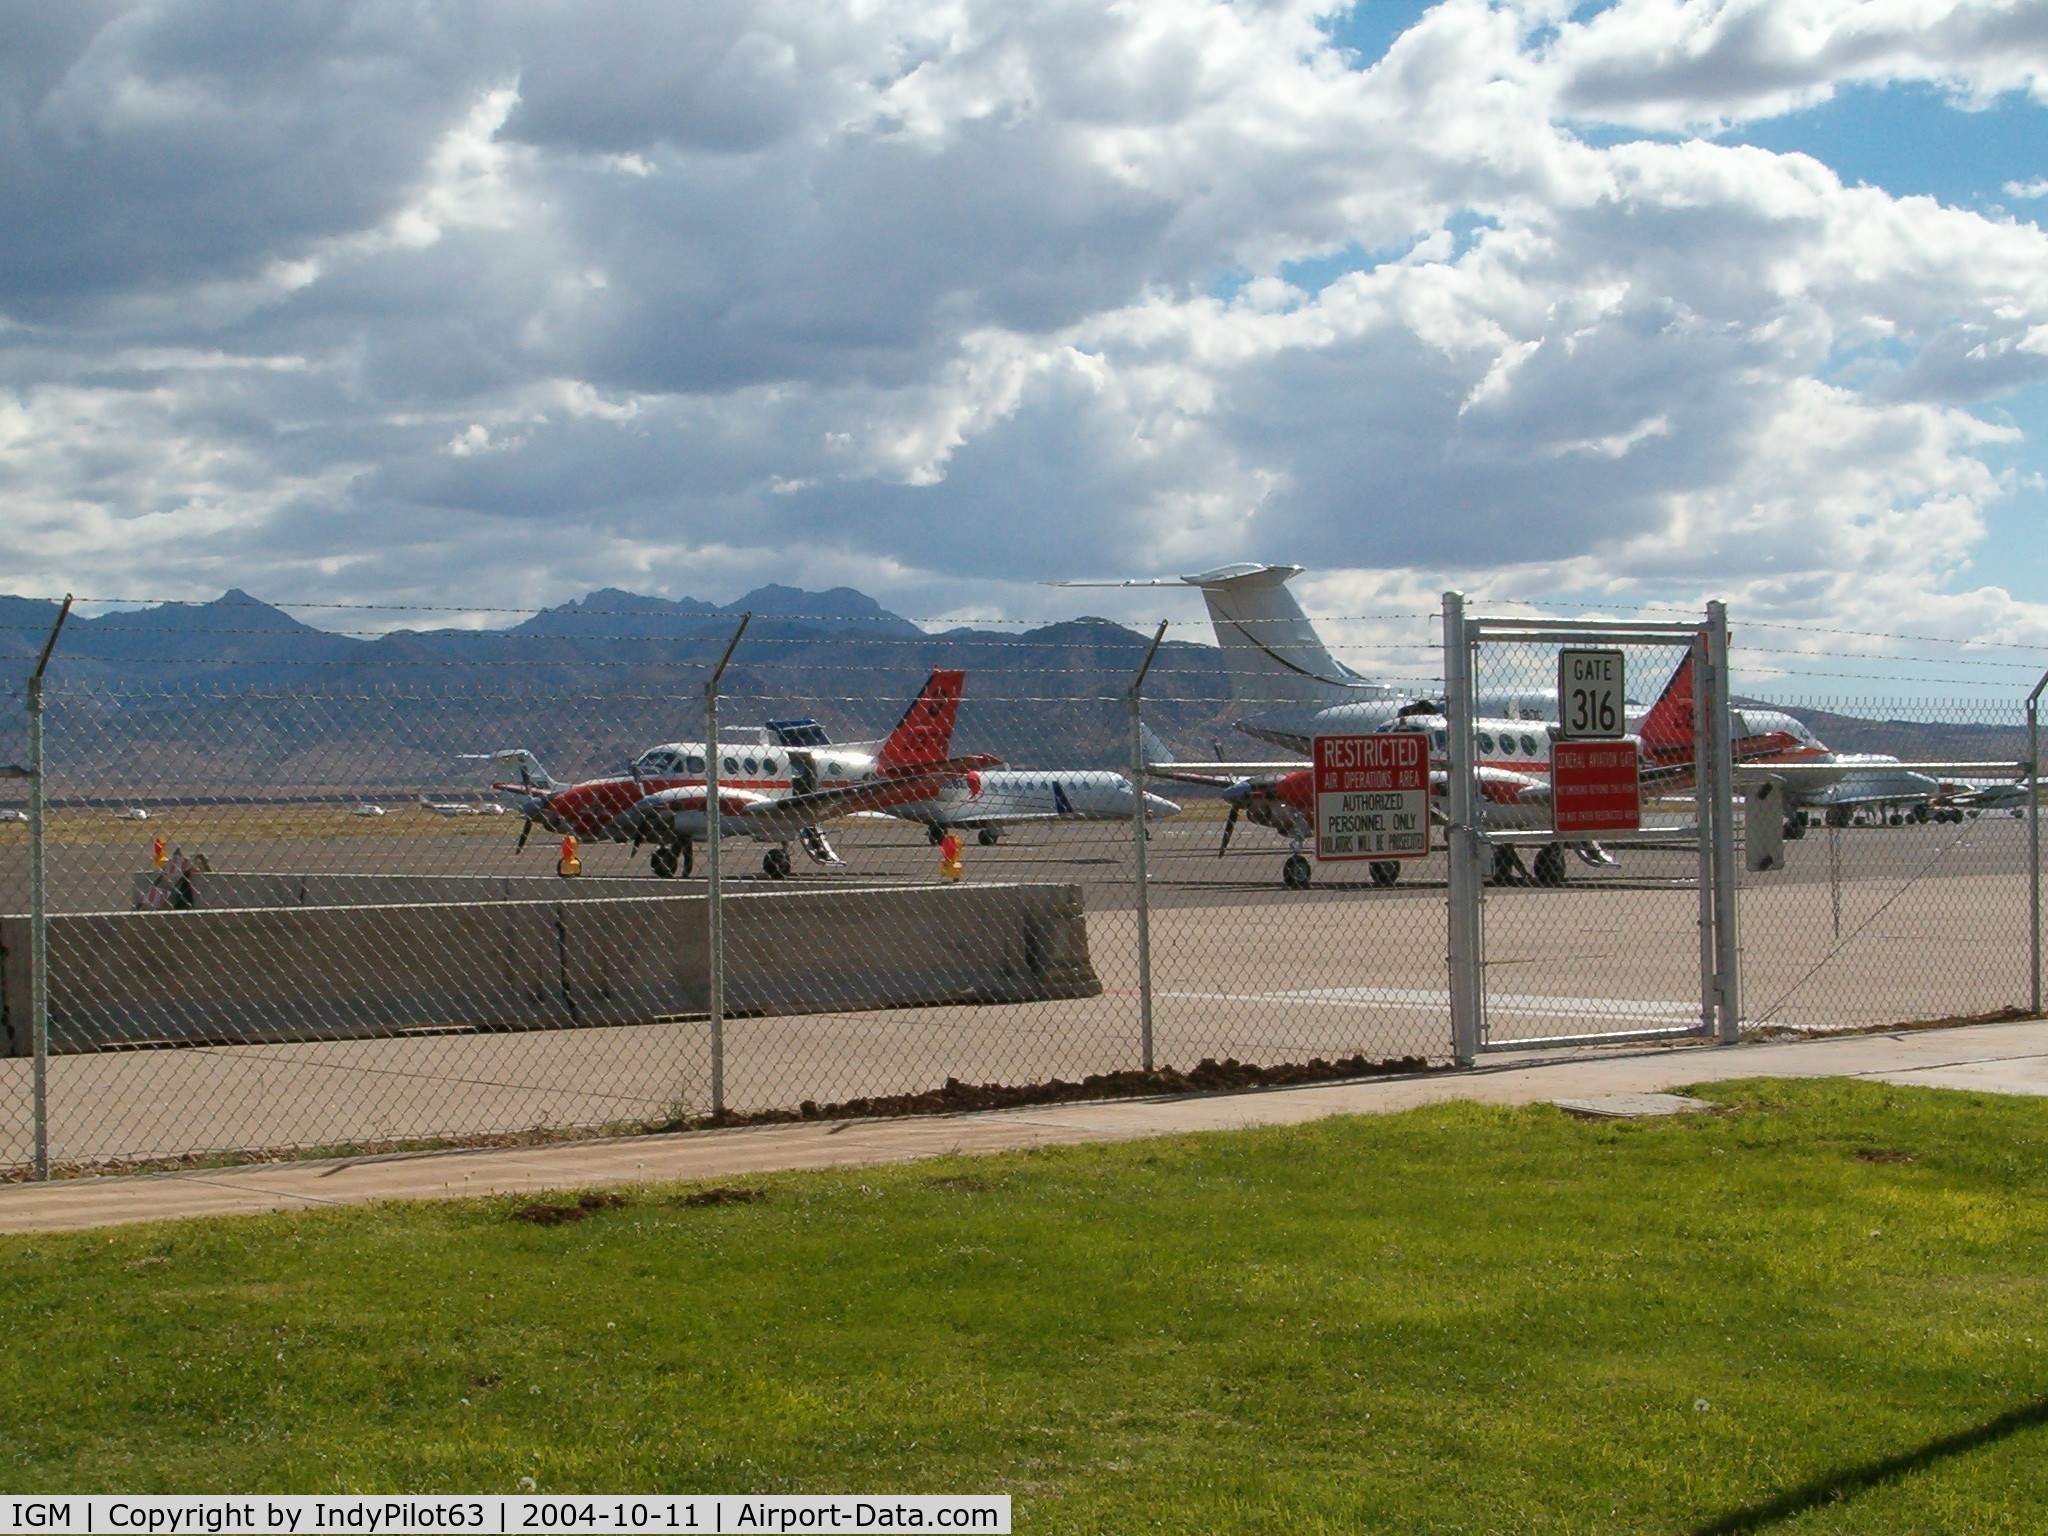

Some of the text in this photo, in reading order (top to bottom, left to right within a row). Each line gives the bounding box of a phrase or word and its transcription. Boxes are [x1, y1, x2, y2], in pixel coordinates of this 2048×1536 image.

[1574, 659, 1612, 681] GATE
[1572, 688, 1616, 731] 316
[1324, 738, 1418, 768] RESTRICTED
[1324, 770, 1420, 789] AIR OPERATIONS AREA
[1342, 793, 1404, 812] AUTHORIZED
[1328, 813, 1417, 833] PERSONNEL ONLY
